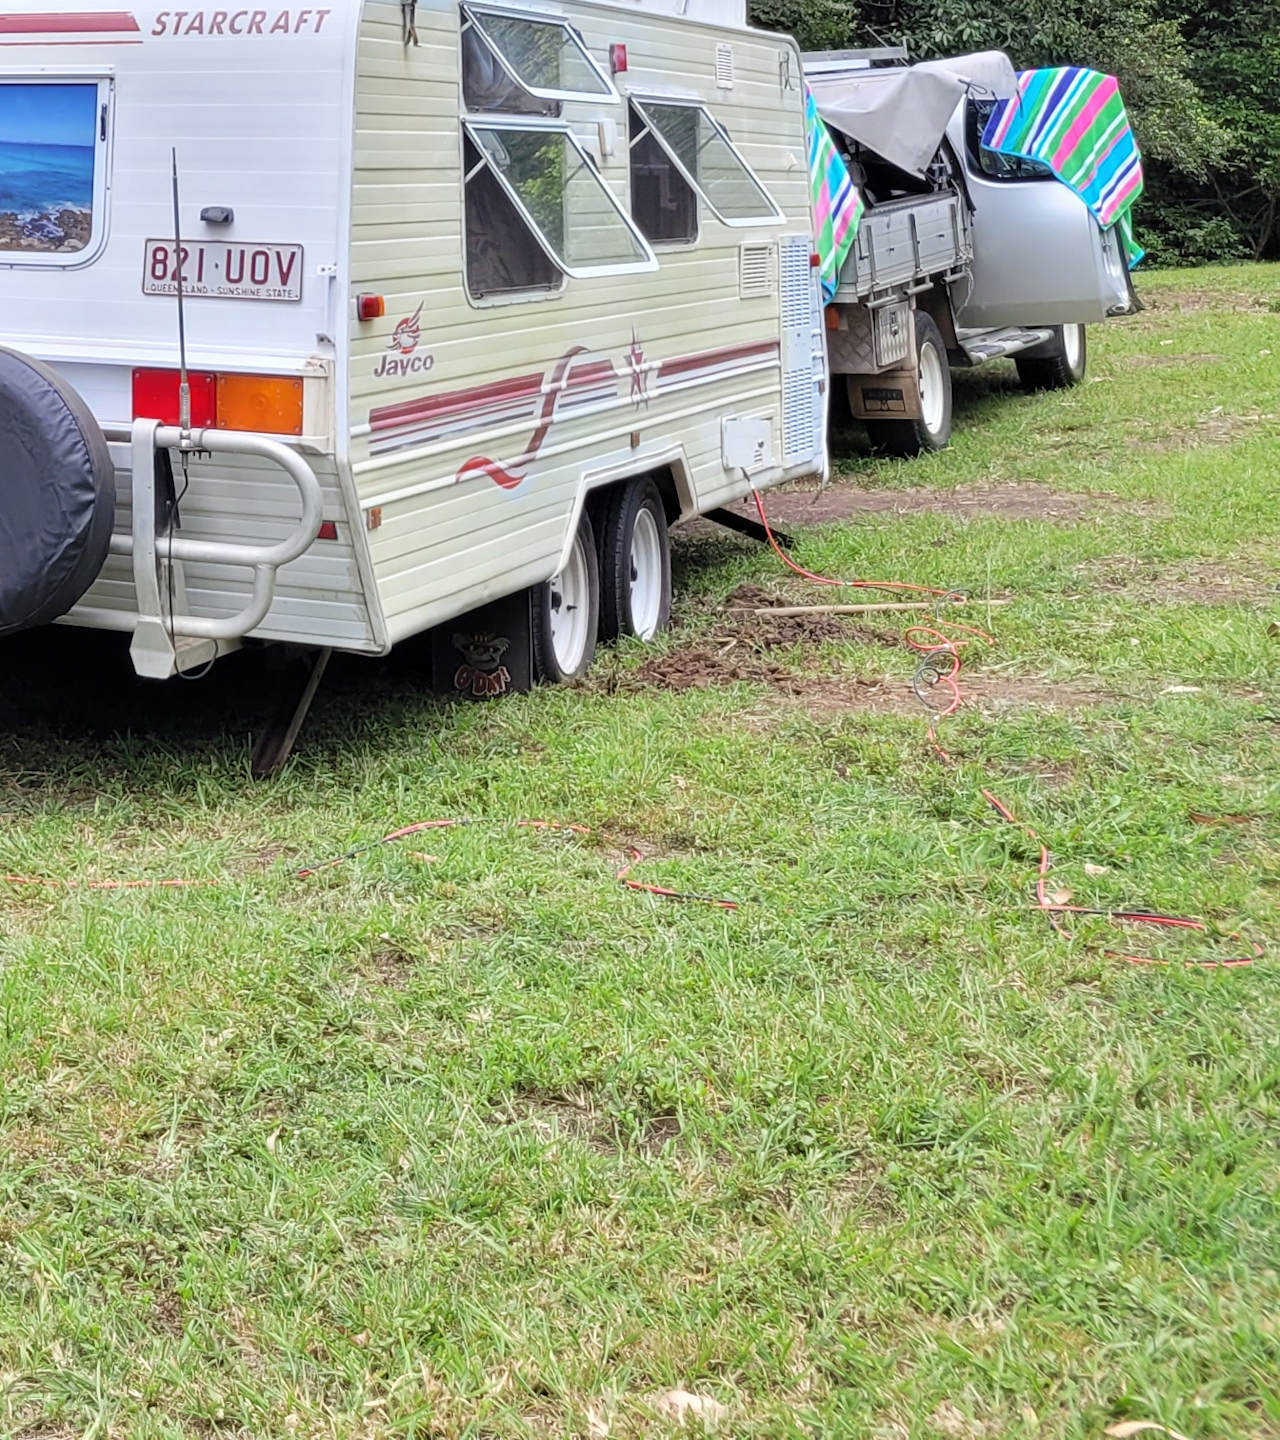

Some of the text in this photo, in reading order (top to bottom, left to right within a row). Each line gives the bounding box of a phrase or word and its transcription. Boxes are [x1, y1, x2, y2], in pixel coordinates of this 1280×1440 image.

[151, 9, 331, 36] STARCRAFT
[151, 246, 297, 287] 821 UOV
[216, 286, 262, 297] SUNSHINE
[265, 288, 293, 298] STATE
[373, 354, 434, 377] Jayco
